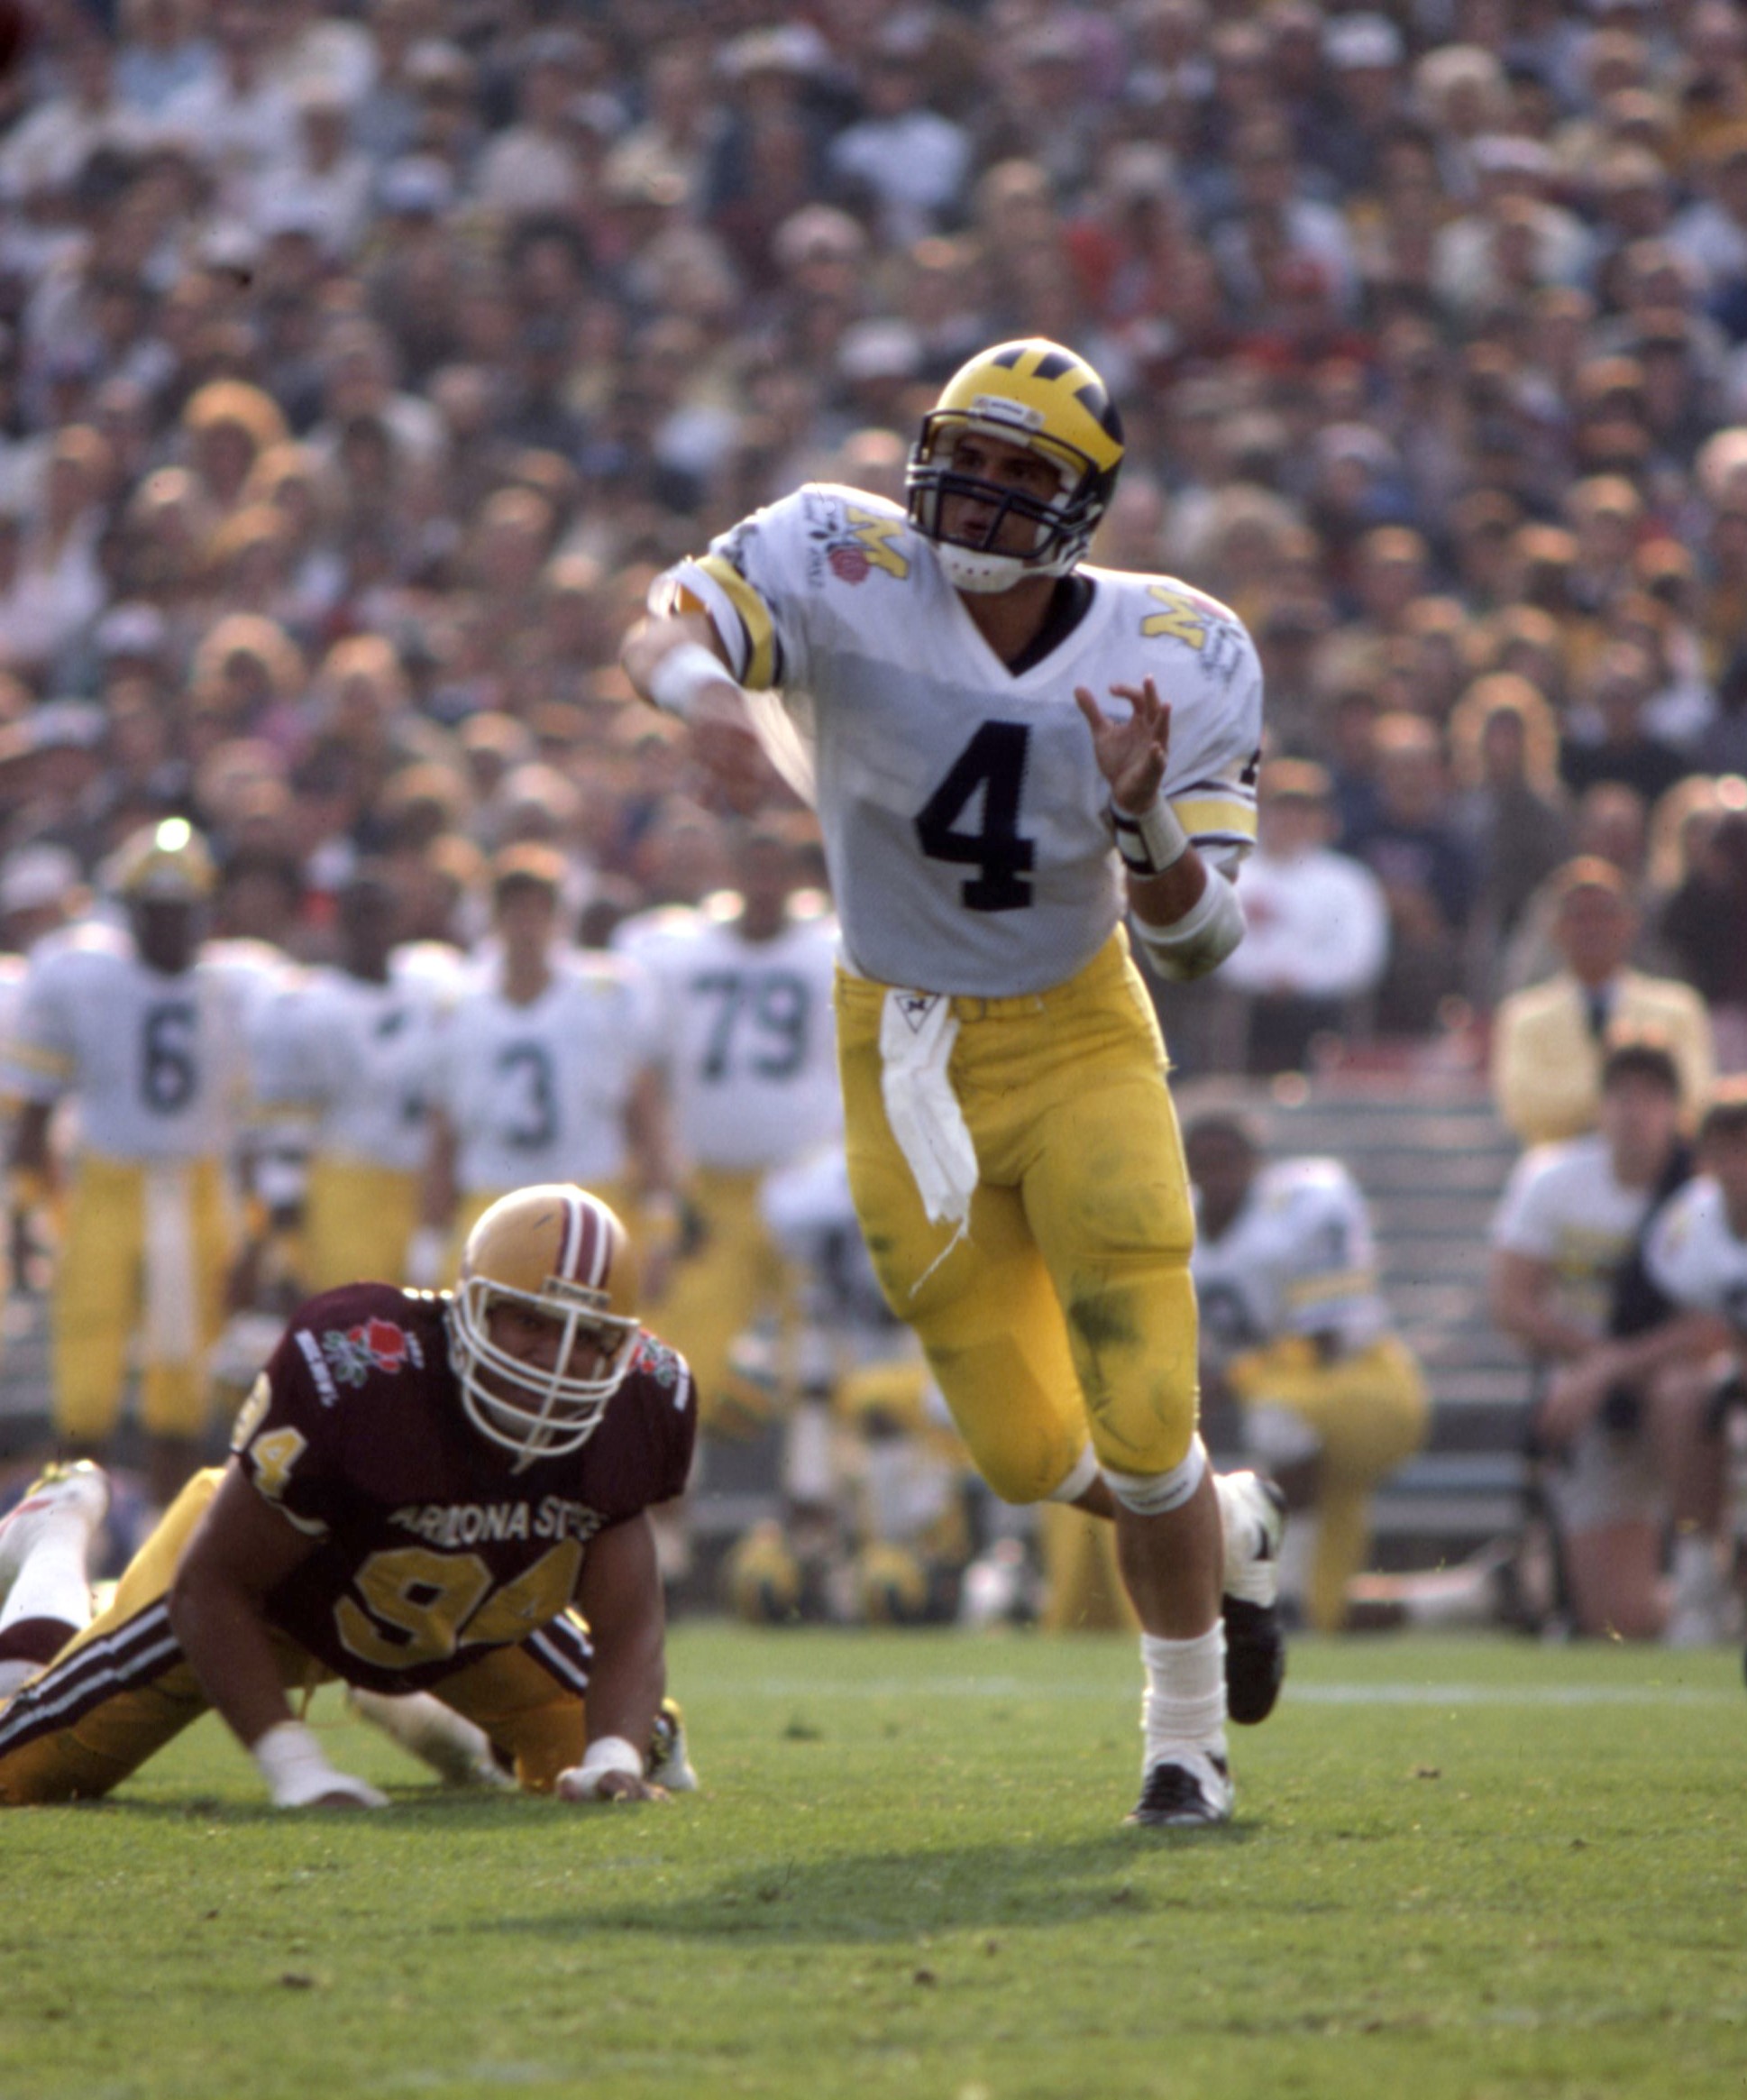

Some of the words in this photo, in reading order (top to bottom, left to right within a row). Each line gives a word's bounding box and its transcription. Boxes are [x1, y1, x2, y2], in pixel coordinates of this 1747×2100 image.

[914, 719, 1036, 912] 4
[141, 1000, 200, 1116] 6
[690, 965, 812, 1086] 79
[497, 1037, 561, 1151] 3
[332, 1536, 584, 1670] 94
